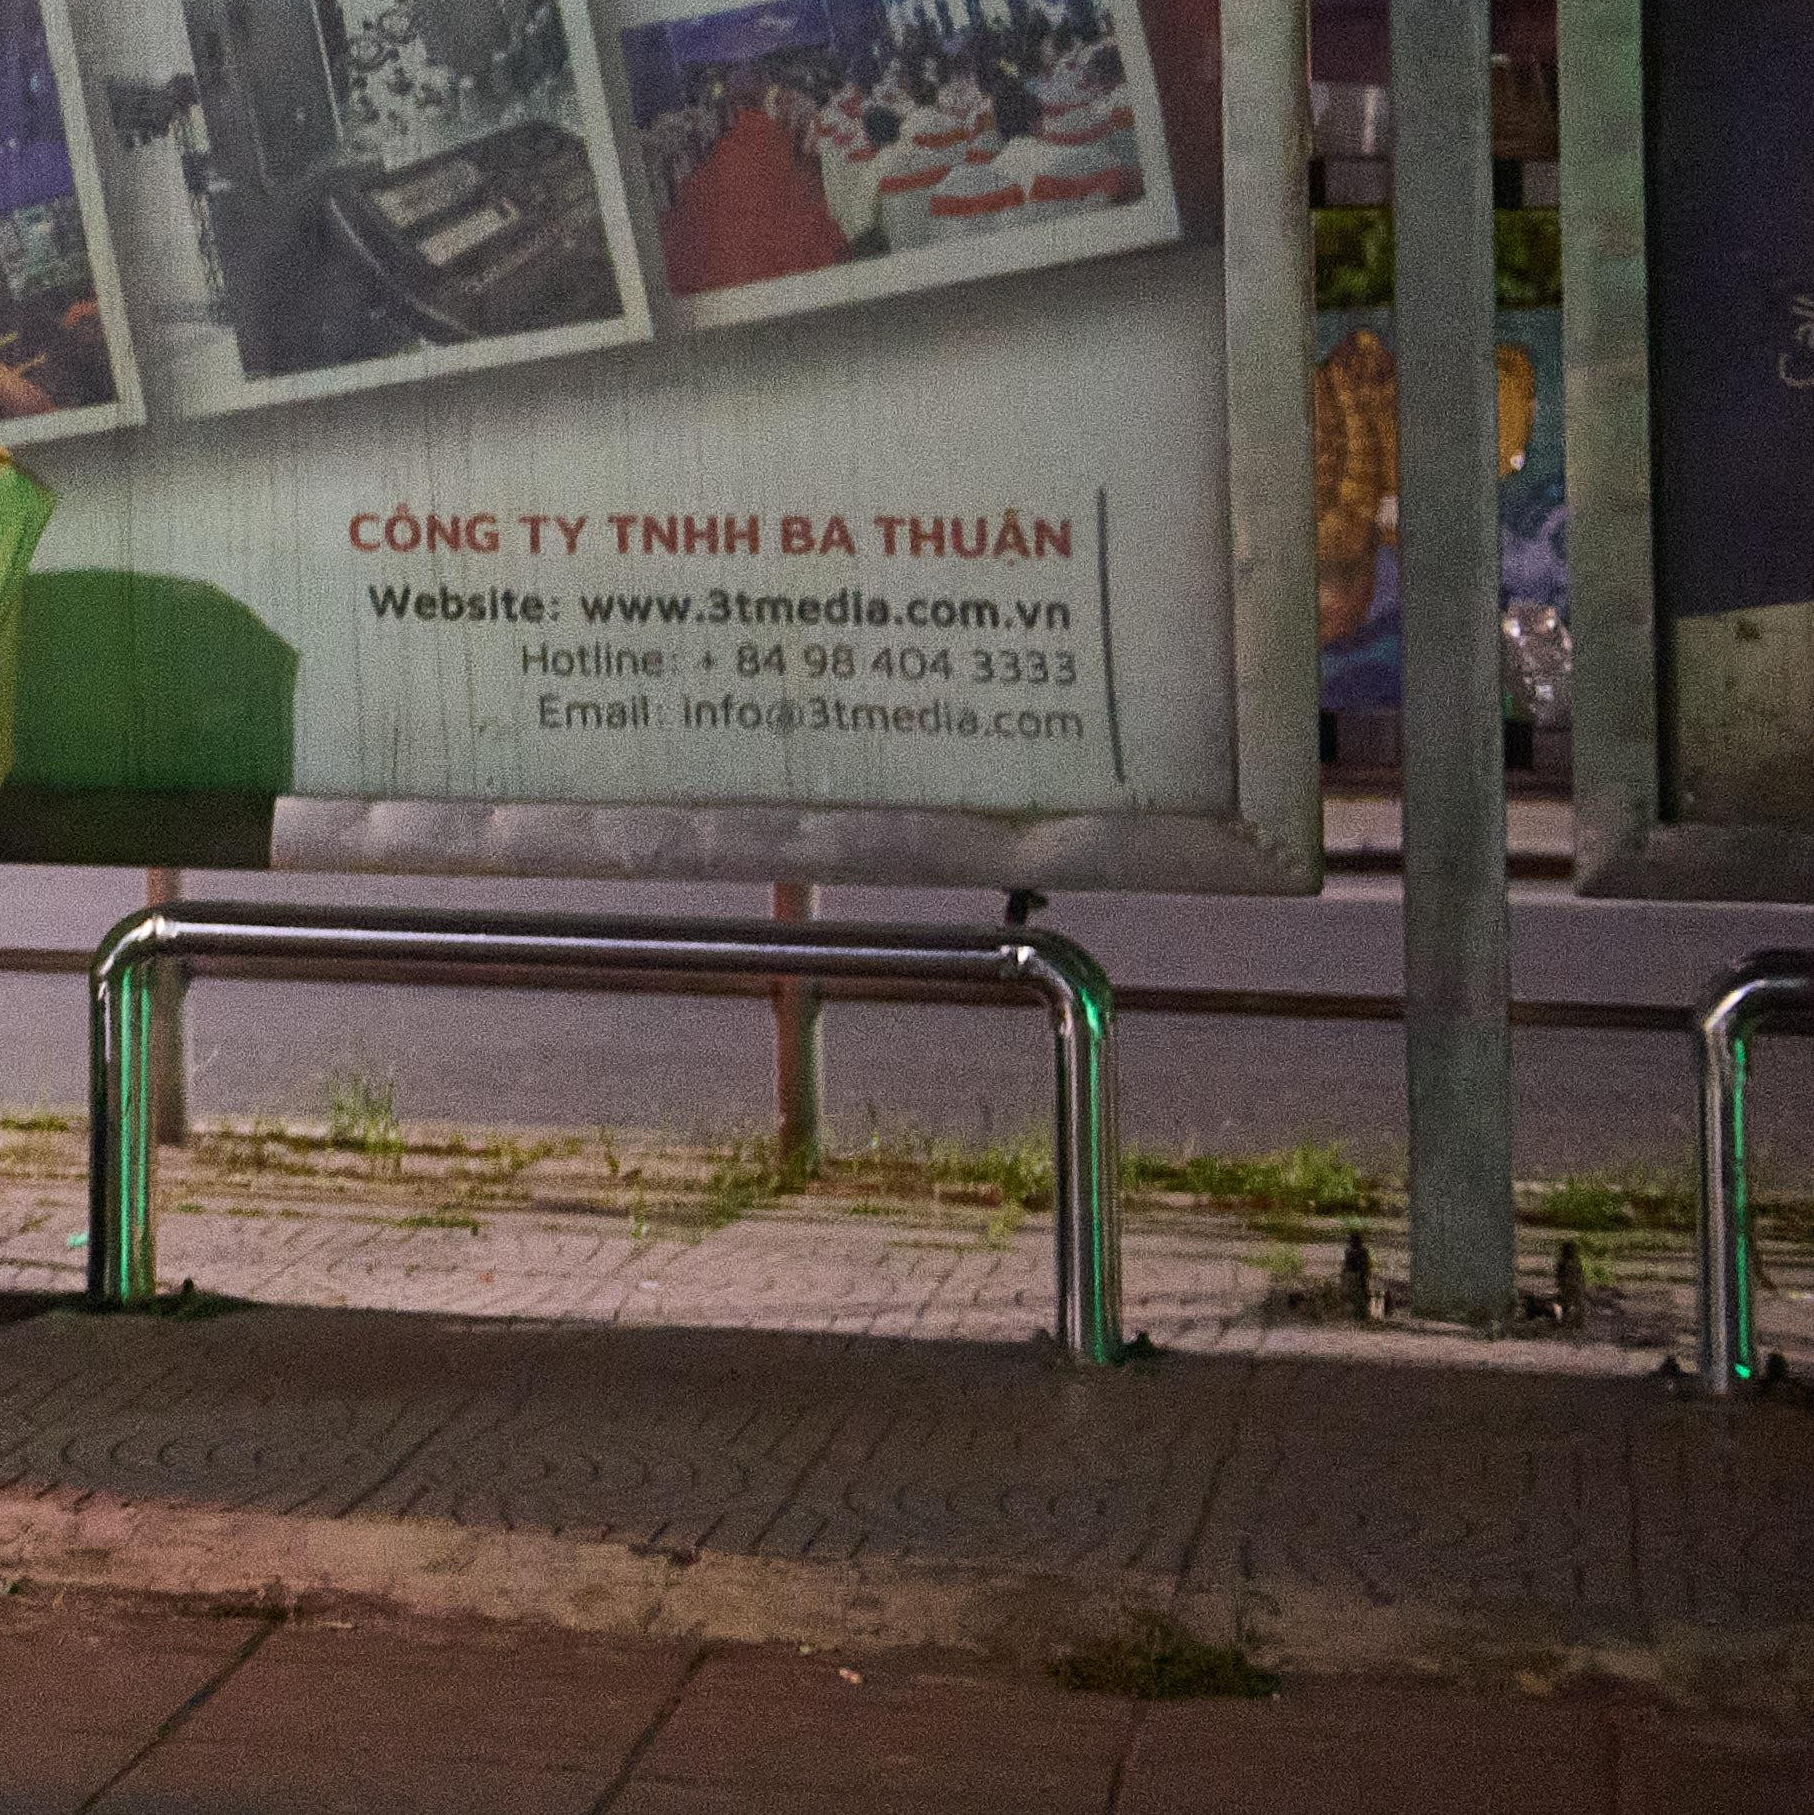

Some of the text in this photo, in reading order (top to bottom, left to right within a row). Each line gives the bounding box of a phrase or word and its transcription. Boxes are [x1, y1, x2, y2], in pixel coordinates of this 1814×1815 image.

[348, 501, 1073, 568] CÔNG TY TNHH BA THUẬN
[368, 586, 1071, 629] Website: www.3tmedia.com.vn
[521, 643, 678, 680] Hotline:
[734, 644, 786, 677] 84
[803, 645, 855, 677] 98
[870, 647, 953, 681] 404
[971, 649, 1077, 685] 3333
[538, 694, 1085, 740] Email: info@3tmedia.com
